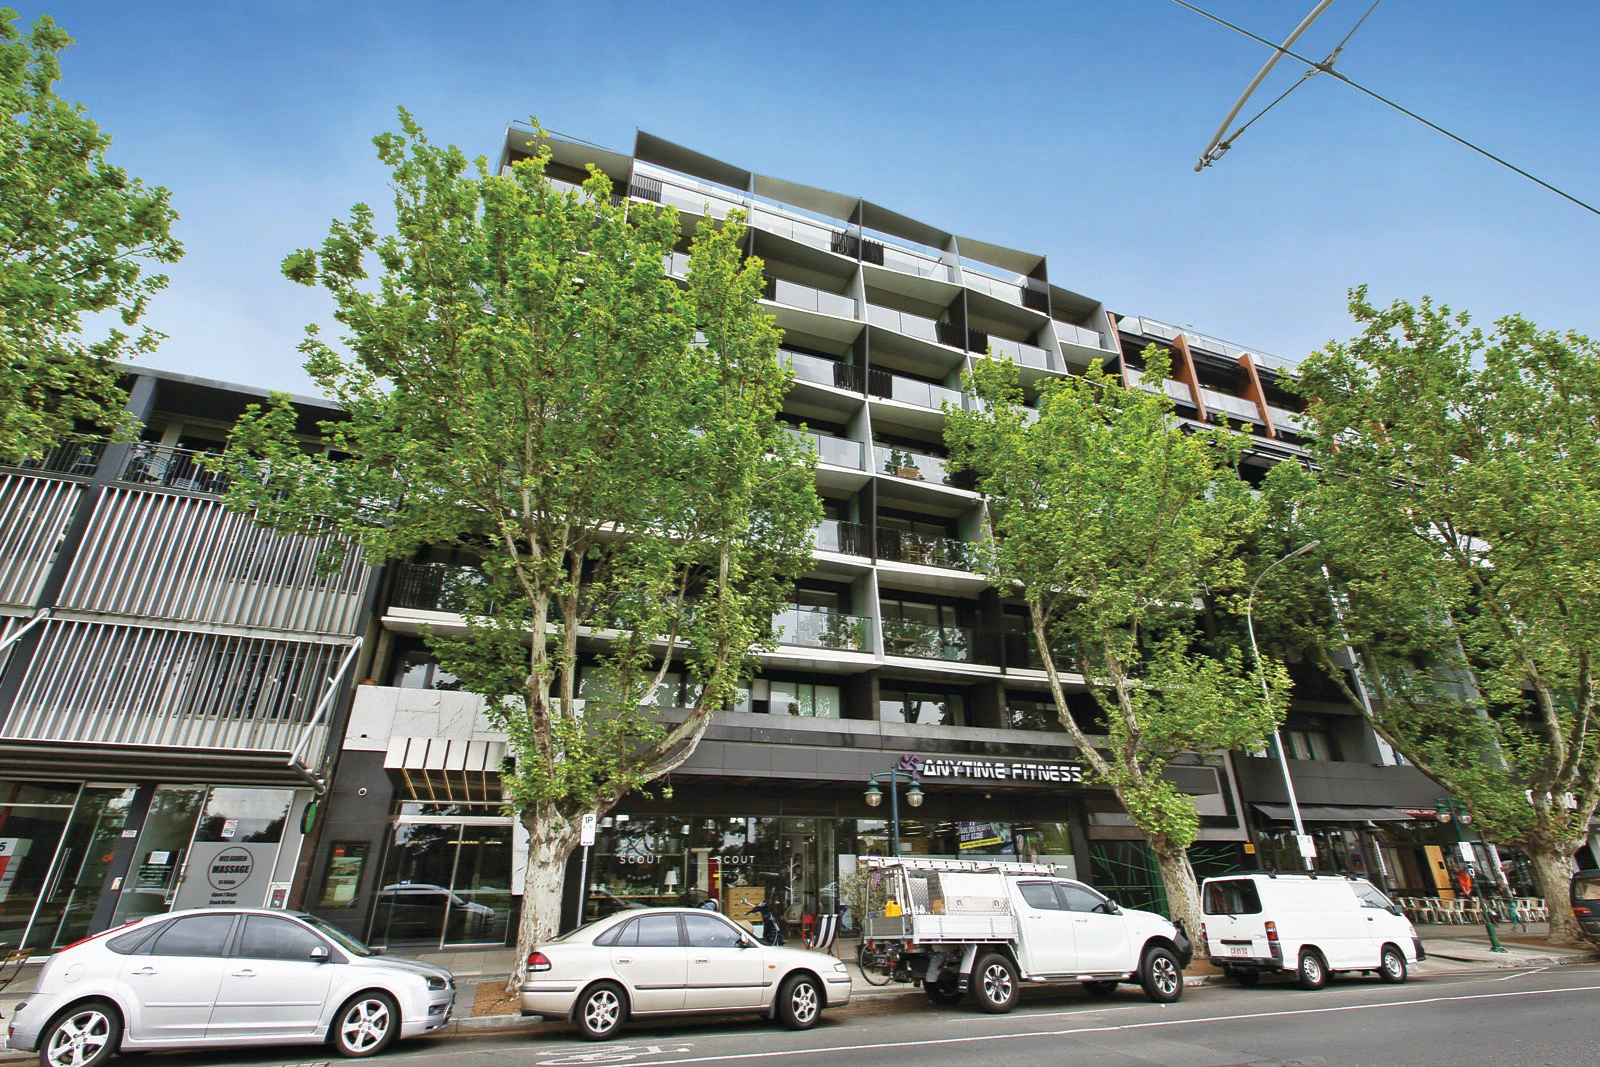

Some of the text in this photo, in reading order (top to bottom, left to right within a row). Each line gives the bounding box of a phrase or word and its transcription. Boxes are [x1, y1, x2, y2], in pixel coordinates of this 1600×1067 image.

[923, 759, 1082, 782] ANYTIME FITNESS
[585, 816, 594, 824] 1P
[620, 855, 662, 864] SCOUT
[716, 855, 755, 864] SCOUT
[212, 865, 250, 873] MASSAGE
